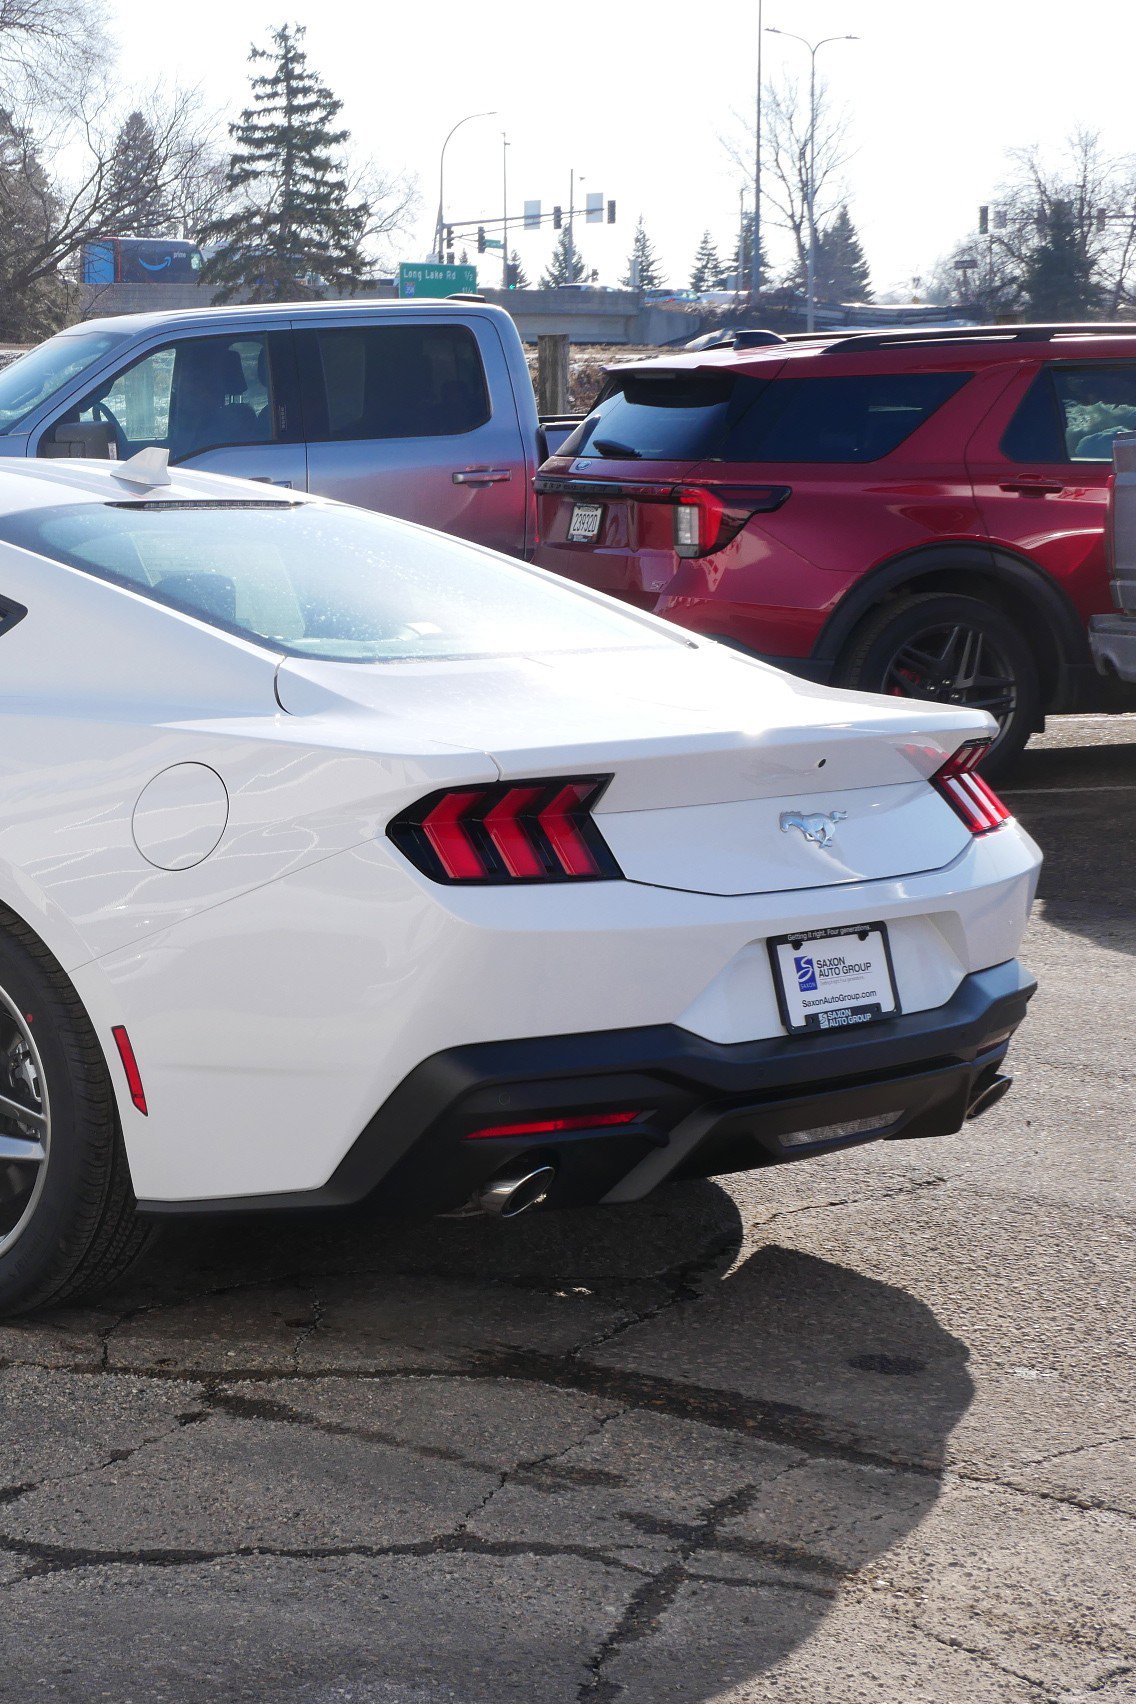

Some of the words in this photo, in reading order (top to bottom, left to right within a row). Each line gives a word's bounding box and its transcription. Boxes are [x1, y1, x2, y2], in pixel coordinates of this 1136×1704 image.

[403, 268, 422, 282] Long
[425, 270, 443, 280] Lake
[446, 271, 456, 280] Rd
[788, 933, 807, 941] Getting
[816, 957, 845, 968] SAXON
[819, 967, 840, 978] AUTO
[842, 962, 871, 974] GROUP
[800, 982, 817, 990] SAXON
[802, 990, 876, 1007] SaxonAutoGroup.com
[827, 1009, 851, 1019] SAXON
[829, 1017, 848, 1027] AUTO
[848, 1013, 871, 1023] GROUP
